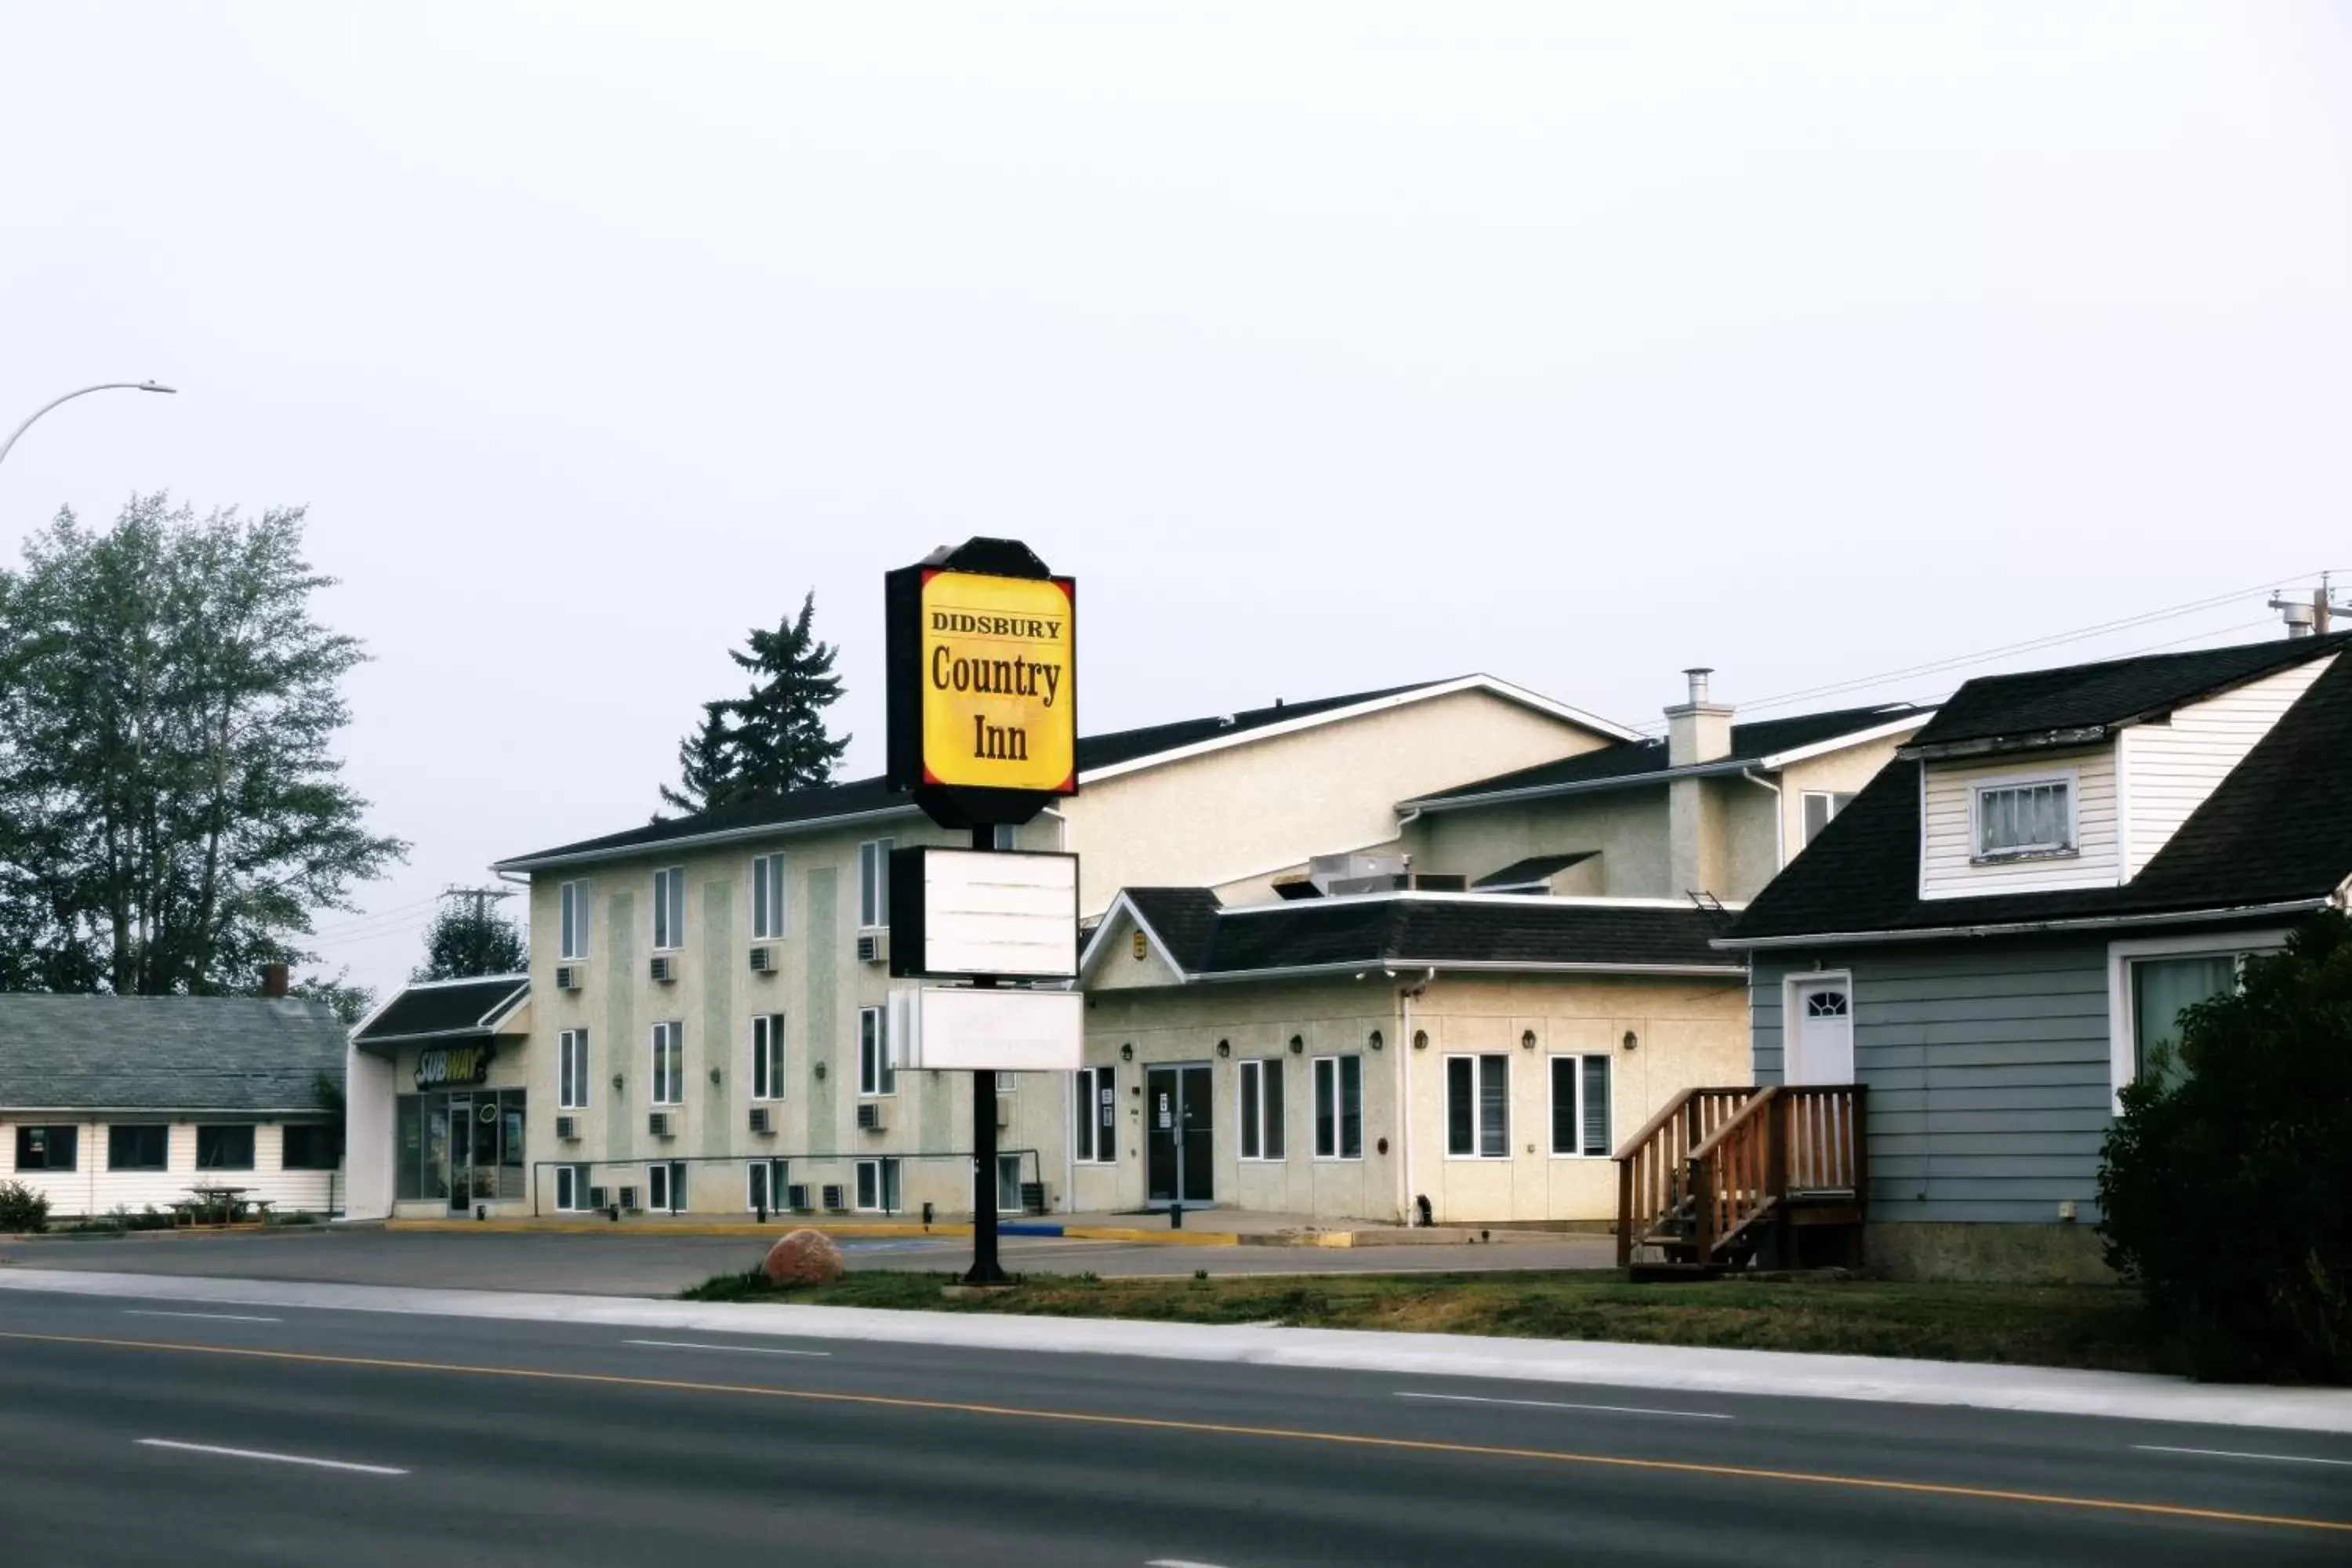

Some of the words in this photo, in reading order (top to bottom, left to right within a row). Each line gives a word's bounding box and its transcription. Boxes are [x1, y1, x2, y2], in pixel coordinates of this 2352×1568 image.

[931, 612, 1062, 638] DIDSBURY
[932, 645, 1061, 707] Country
[975, 715, 1028, 760] Inn
[416, 1047, 485, 1082] SUBWAY
